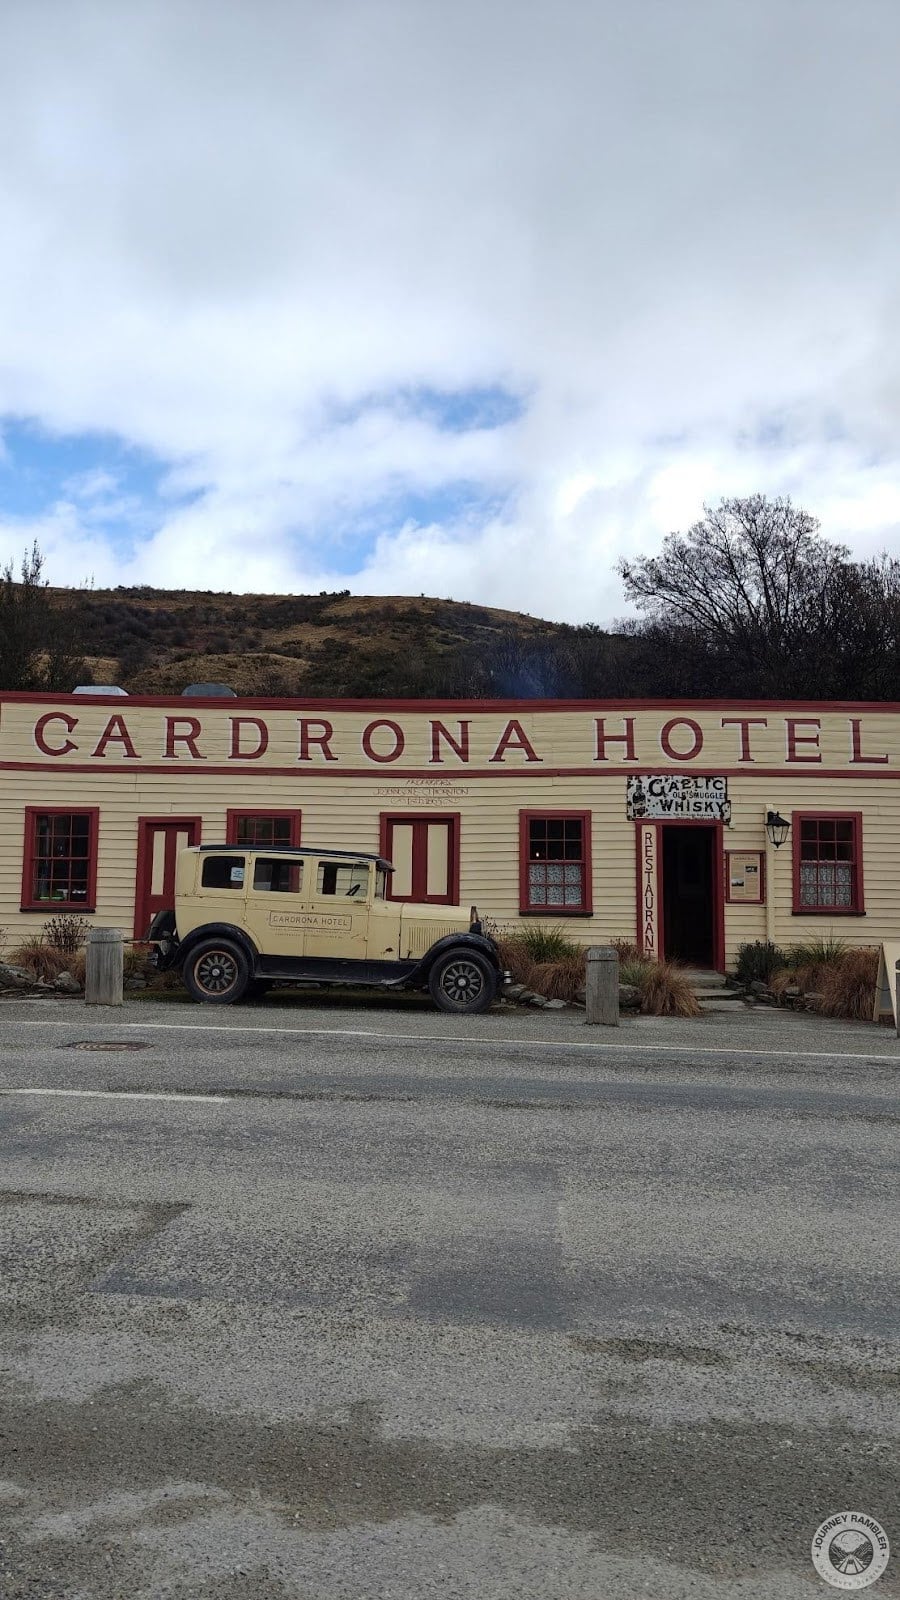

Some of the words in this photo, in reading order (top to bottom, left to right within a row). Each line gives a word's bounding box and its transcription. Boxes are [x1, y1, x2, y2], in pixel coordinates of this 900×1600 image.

[34, 711, 544, 763] CARDRONA
[593, 717, 889, 764] HOTEL
[648, 778, 724, 797] GAELIC
[659, 799, 723, 813] WHISKY
[644, 832, 655, 958] RESTAURANT
[273, 915, 319, 925] CARDRONA
[321, 917, 348, 926] HOTEL
